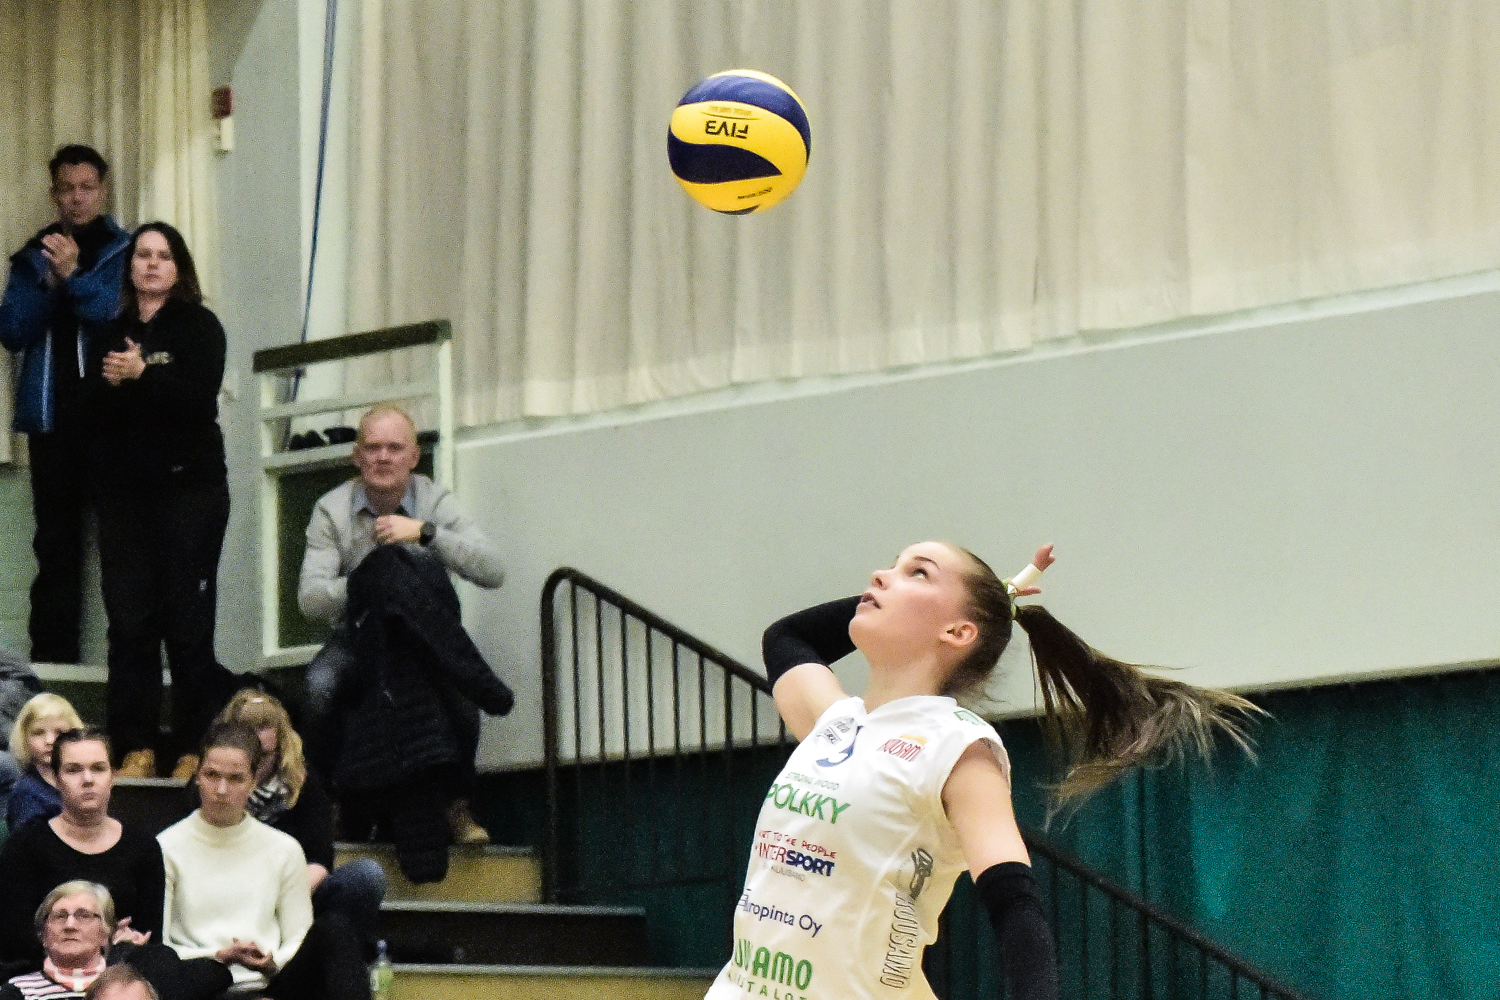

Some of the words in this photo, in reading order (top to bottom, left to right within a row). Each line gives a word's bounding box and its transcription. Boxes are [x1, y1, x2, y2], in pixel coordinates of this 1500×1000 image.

[760, 842, 836, 877] INTERSPORT
[802, 840, 837, 859] PEOPLE
[799, 914, 822, 938] Oy
